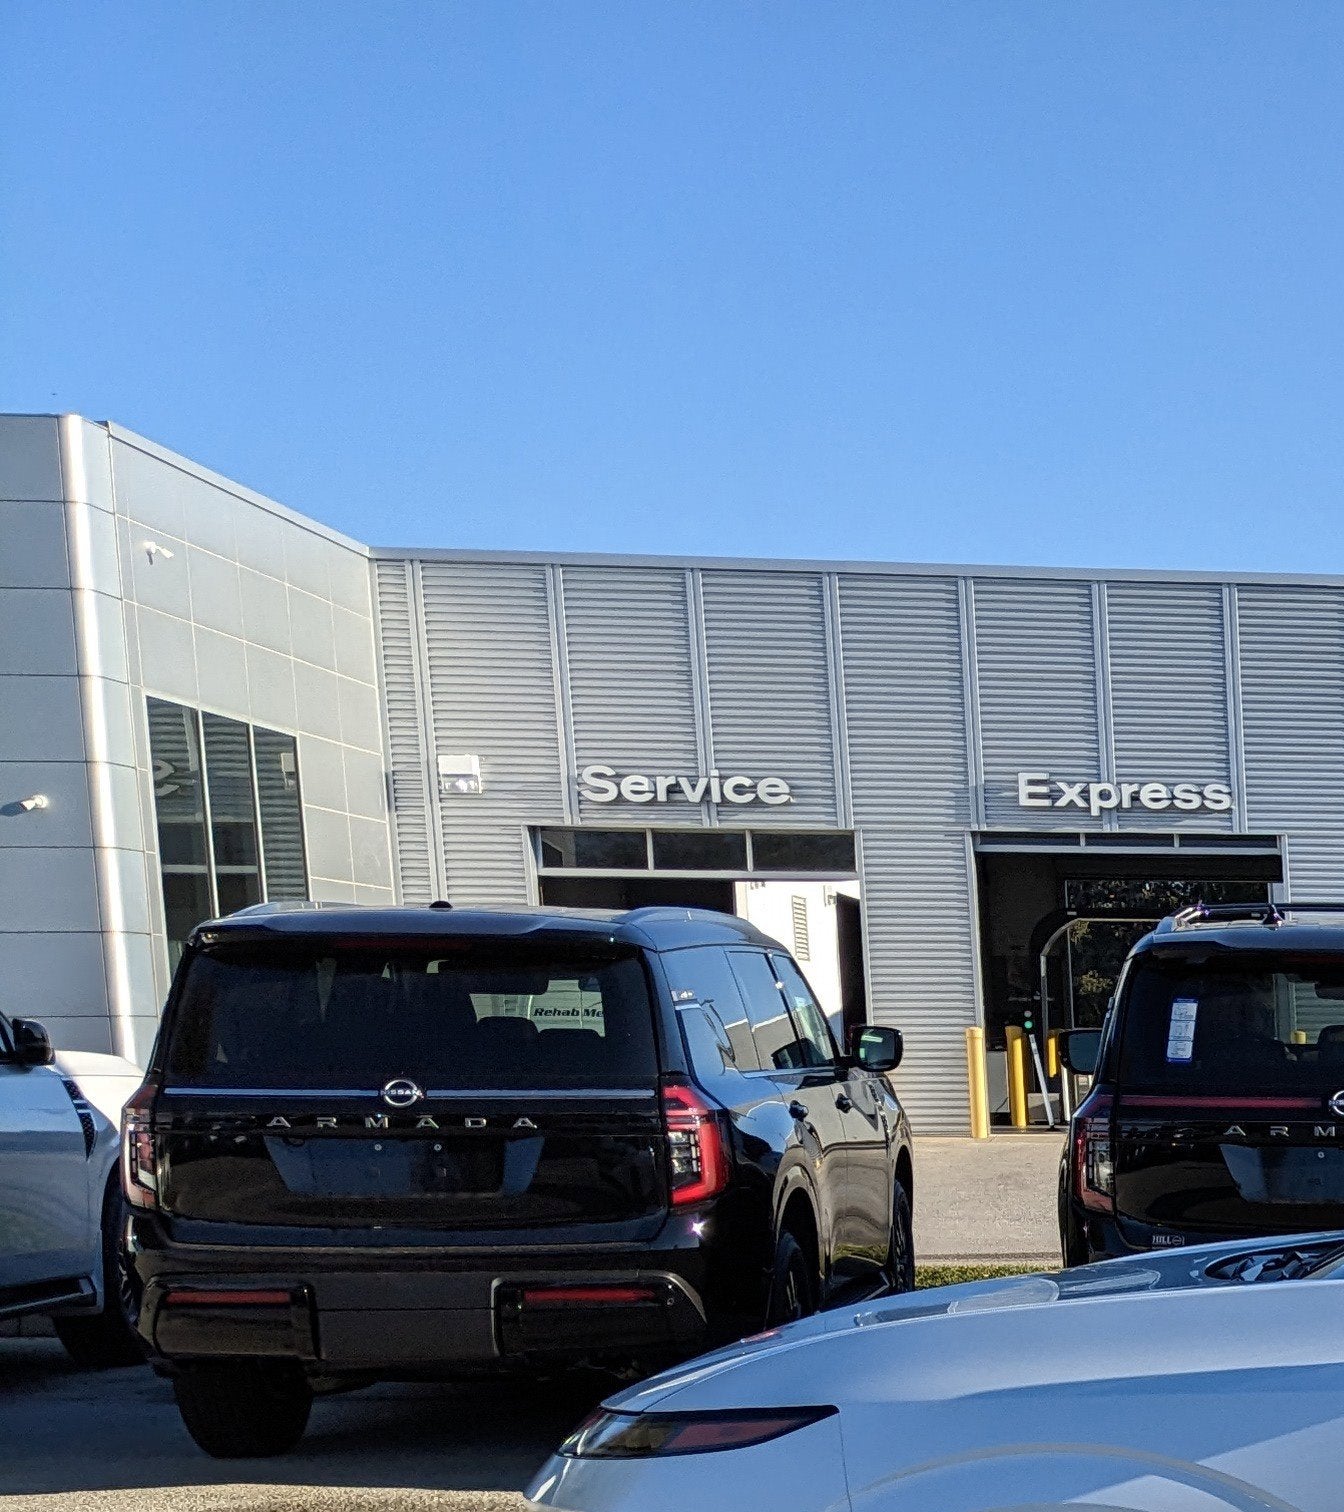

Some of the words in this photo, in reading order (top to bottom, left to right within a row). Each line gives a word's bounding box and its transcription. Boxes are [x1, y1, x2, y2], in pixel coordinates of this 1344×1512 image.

[580, 764, 791, 805] Service
[1017, 772, 1233, 817] Express
[533, 1007, 580, 1017] Rehab
[266, 1116, 538, 1129] ARMADA
